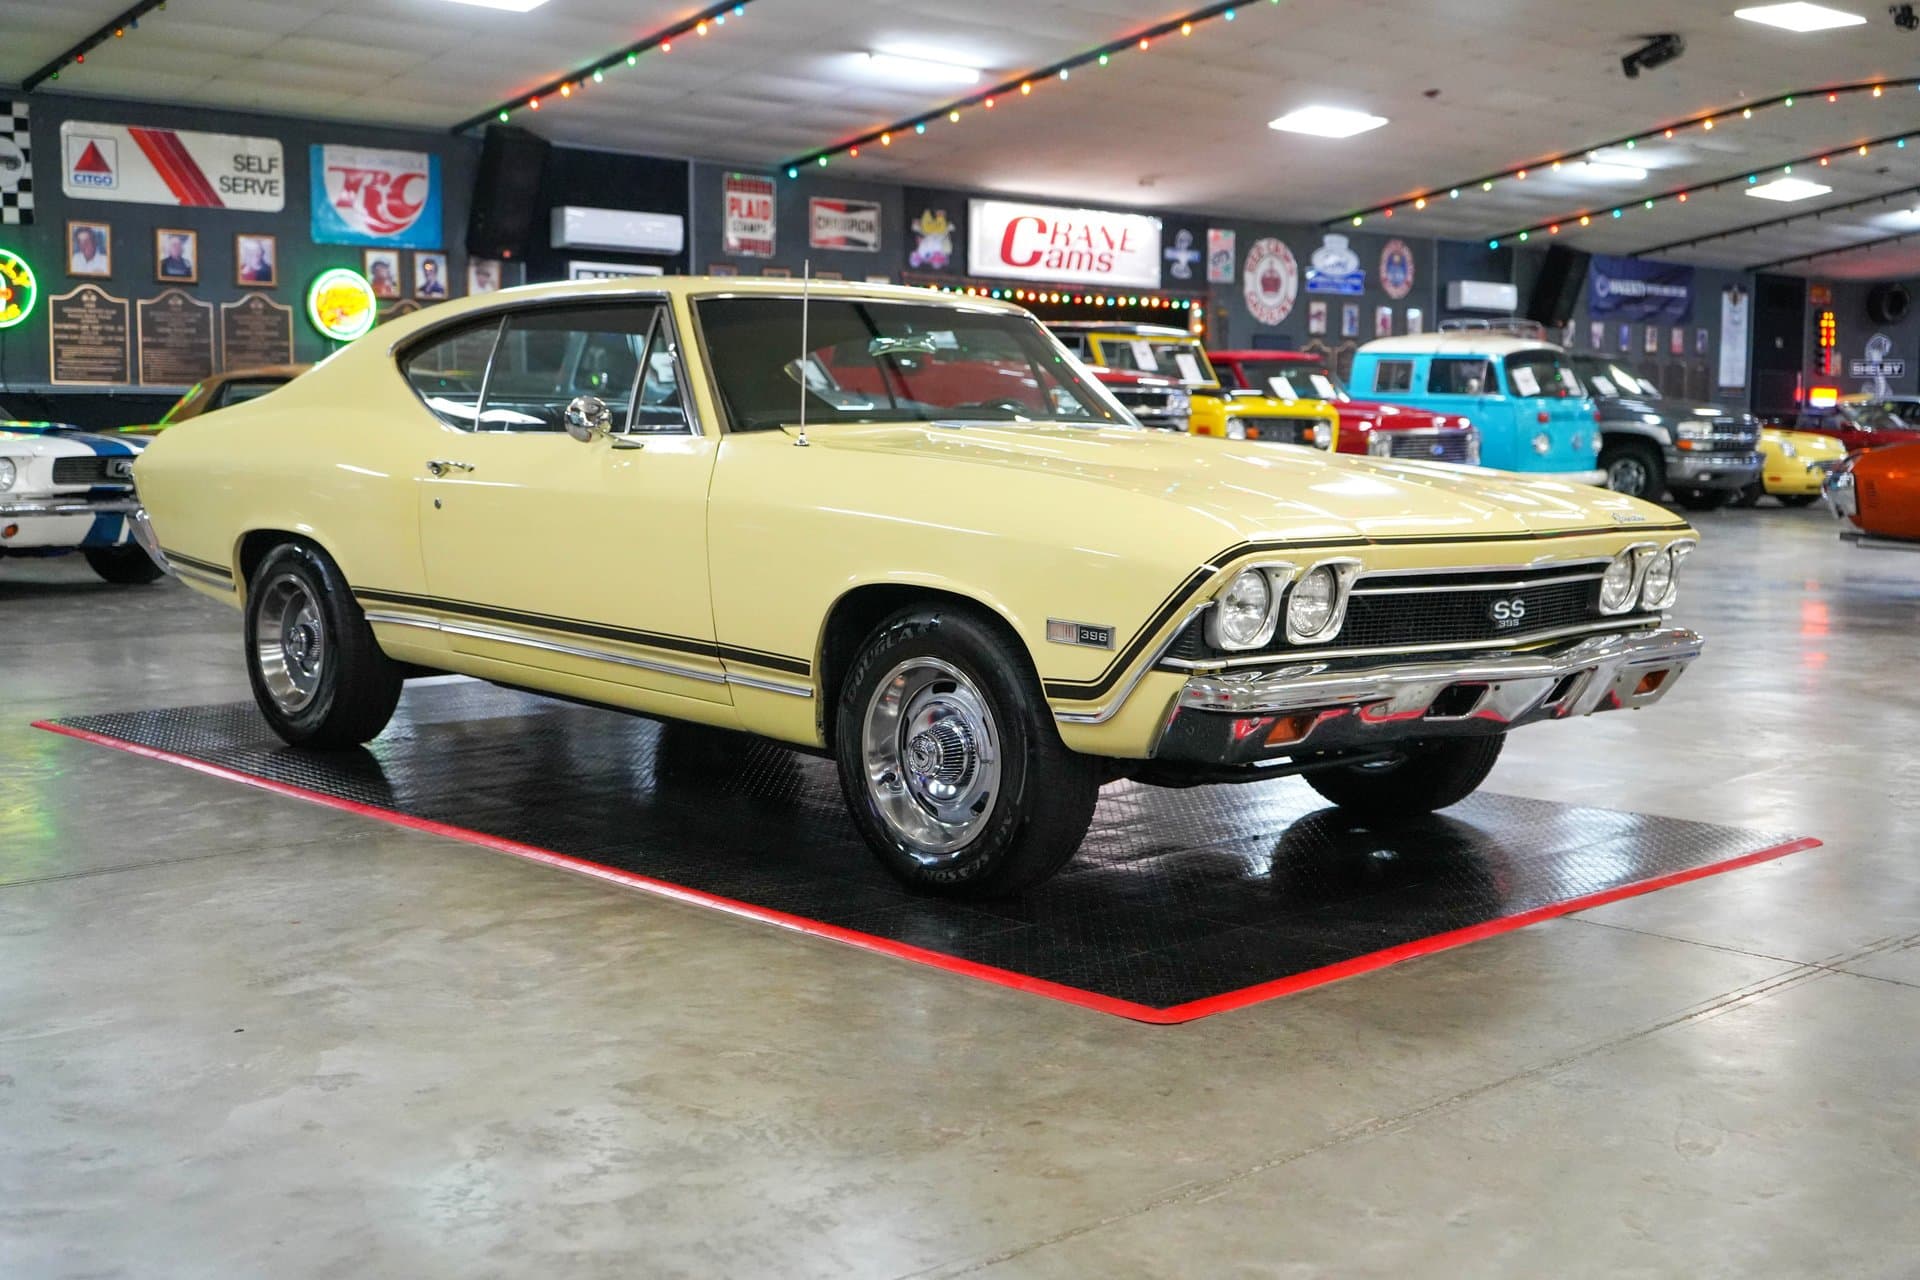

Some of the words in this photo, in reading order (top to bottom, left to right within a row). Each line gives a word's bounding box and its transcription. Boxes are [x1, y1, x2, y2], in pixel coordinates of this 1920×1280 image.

[233, 154, 279, 174] SELF
[73, 174, 113, 186] CITGO
[219, 176, 280, 197] SERVE
[328, 167, 427, 234] RC
[729, 197, 770, 221] PLAID
[1853, 362, 1902, 376] SHELBY
[1493, 600, 1525, 620] SS
[1500, 619, 1520, 628] 396
[1081, 630, 1107, 642] 396
